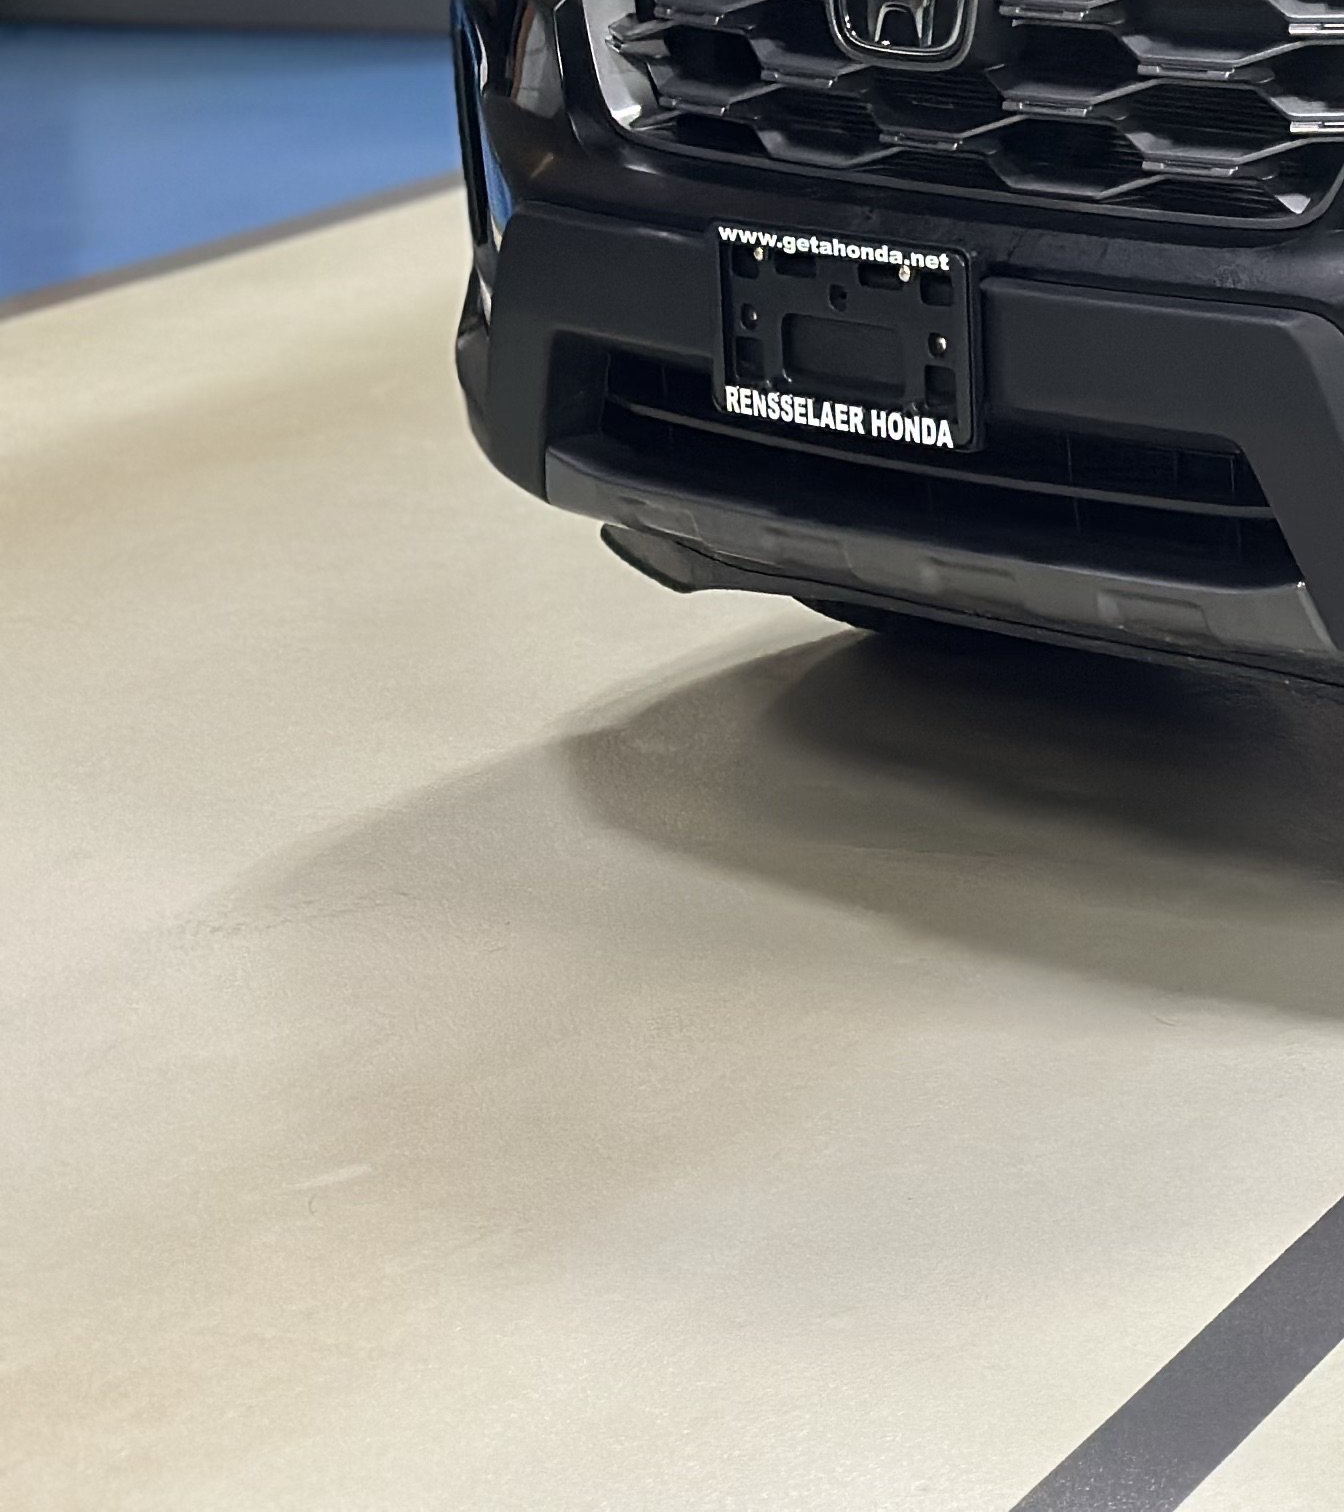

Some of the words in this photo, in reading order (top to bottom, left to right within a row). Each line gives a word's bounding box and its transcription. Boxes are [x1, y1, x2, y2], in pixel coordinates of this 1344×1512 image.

[719, 226, 949, 271] www.getahonda.net
[726, 385, 865, 434] RENSSELAER
[871, 409, 953, 448] HONDA
